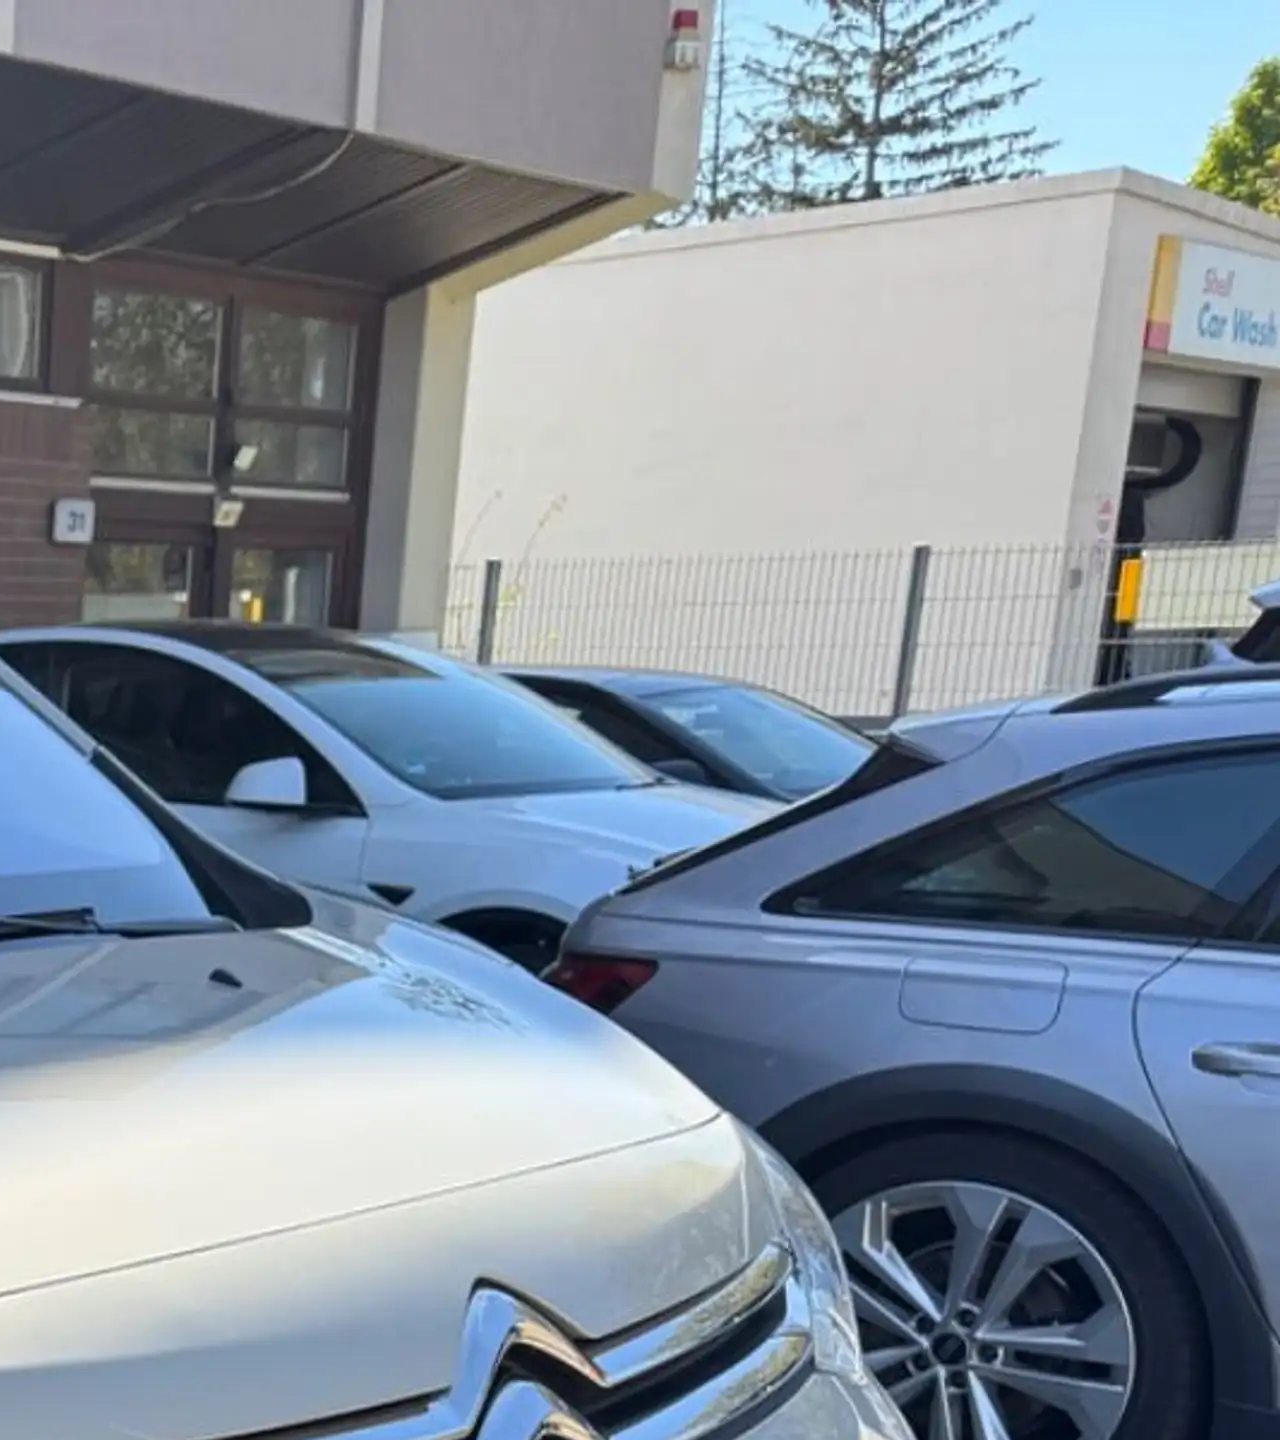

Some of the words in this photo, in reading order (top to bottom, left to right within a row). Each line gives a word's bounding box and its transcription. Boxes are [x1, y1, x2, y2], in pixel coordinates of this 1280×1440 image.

[1203, 267, 1236, 297] Shell
[1197, 301, 1228, 339] Car
[1232, 306, 1277, 347] Wash
[67, 509, 87, 533] 31
